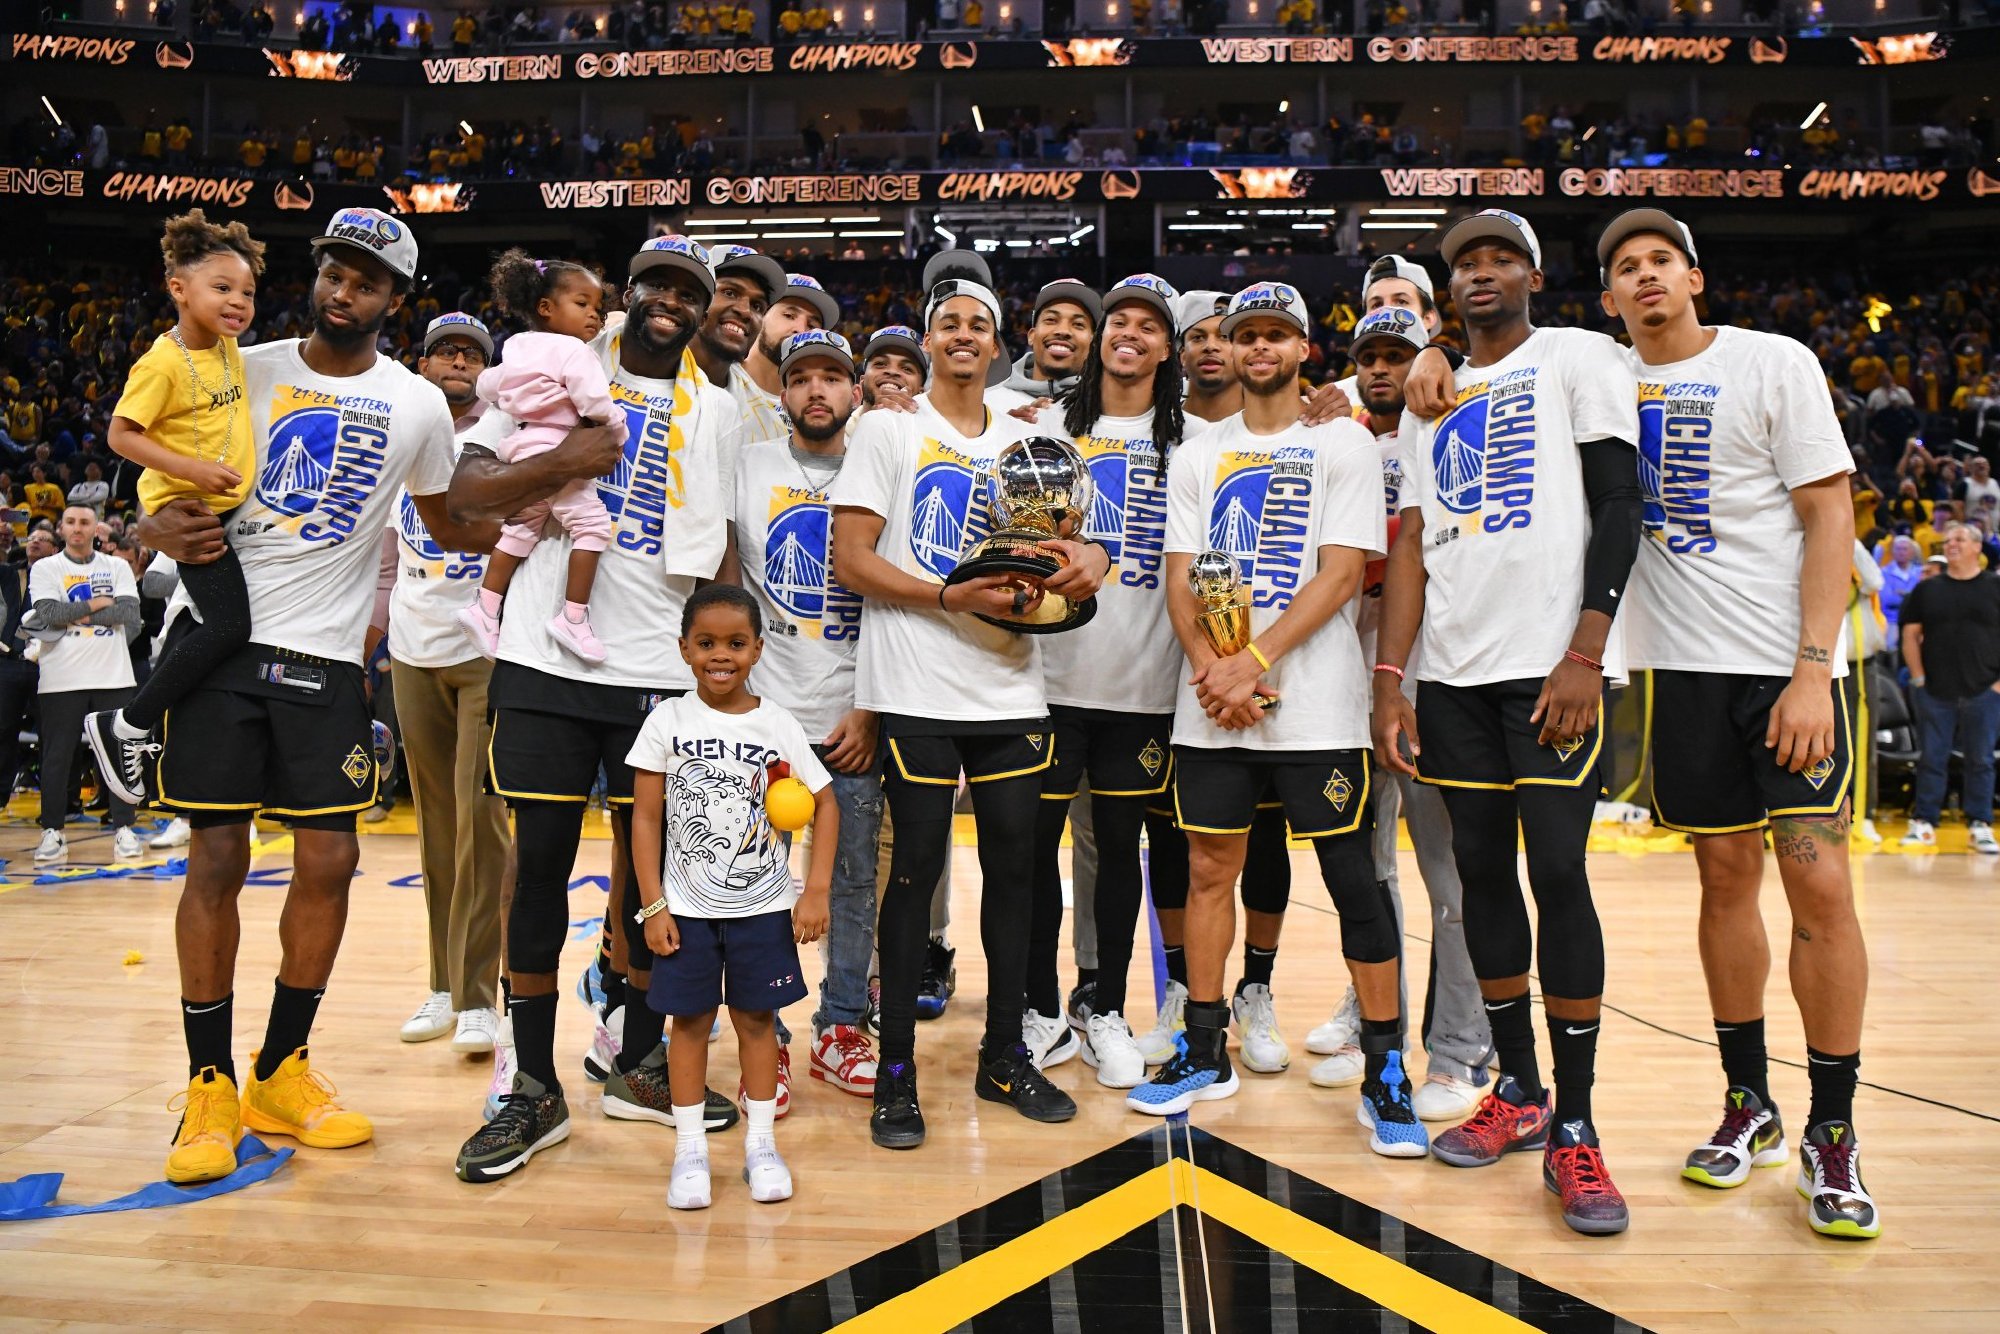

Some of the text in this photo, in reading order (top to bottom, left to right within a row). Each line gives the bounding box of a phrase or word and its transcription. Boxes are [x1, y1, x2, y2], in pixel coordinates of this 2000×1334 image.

[1200, 36, 1728, 63] WESTERN CONFERENCE CHAMPIONS
[422, 42, 922, 84] WESTERN CONFERENCE CHAMPIONS
[103, 172, 254, 208] CHAMPIONS
[540, 172, 1082, 209] WESTERN CONFERENCE CHAMPIONS
[1381, 168, 1947, 201] WESTERN CONFERENCE CHAMPIONS
[340, 213, 374, 229] NBA
[654, 241, 687, 251] NBA
[1125, 278, 1152, 287] NBA
[1241, 290, 1270, 303] NBA
[440, 316, 467, 325] NBA
[1364, 312, 1390, 325] NBA
[792, 332, 823, 345] NBA
[1487, 366, 1540, 388] WESTERN
[1492, 378, 1536, 401] CONFERENCE
[1661, 382, 1722, 398] WESTERN
[334, 395, 393, 414] WESTERN
[1665, 400, 1715, 417] CONFERENCE
[342, 410, 391, 430] CONFERENCE
[1272, 461, 1314, 478] CONFERENCE
[1483, 393, 1536, 534] CHAMPS
[300, 424, 388, 547] CHAMPS
[616, 421, 671, 556] CHAMPS
[1663, 416, 1717, 554] CHAMPS
[1120, 467, 1168, 590] CHAMPS
[1252, 476, 1312, 611] CHAMPS
[673, 736, 780, 768] KENZO
[644, 899, 665, 916] CHASE
